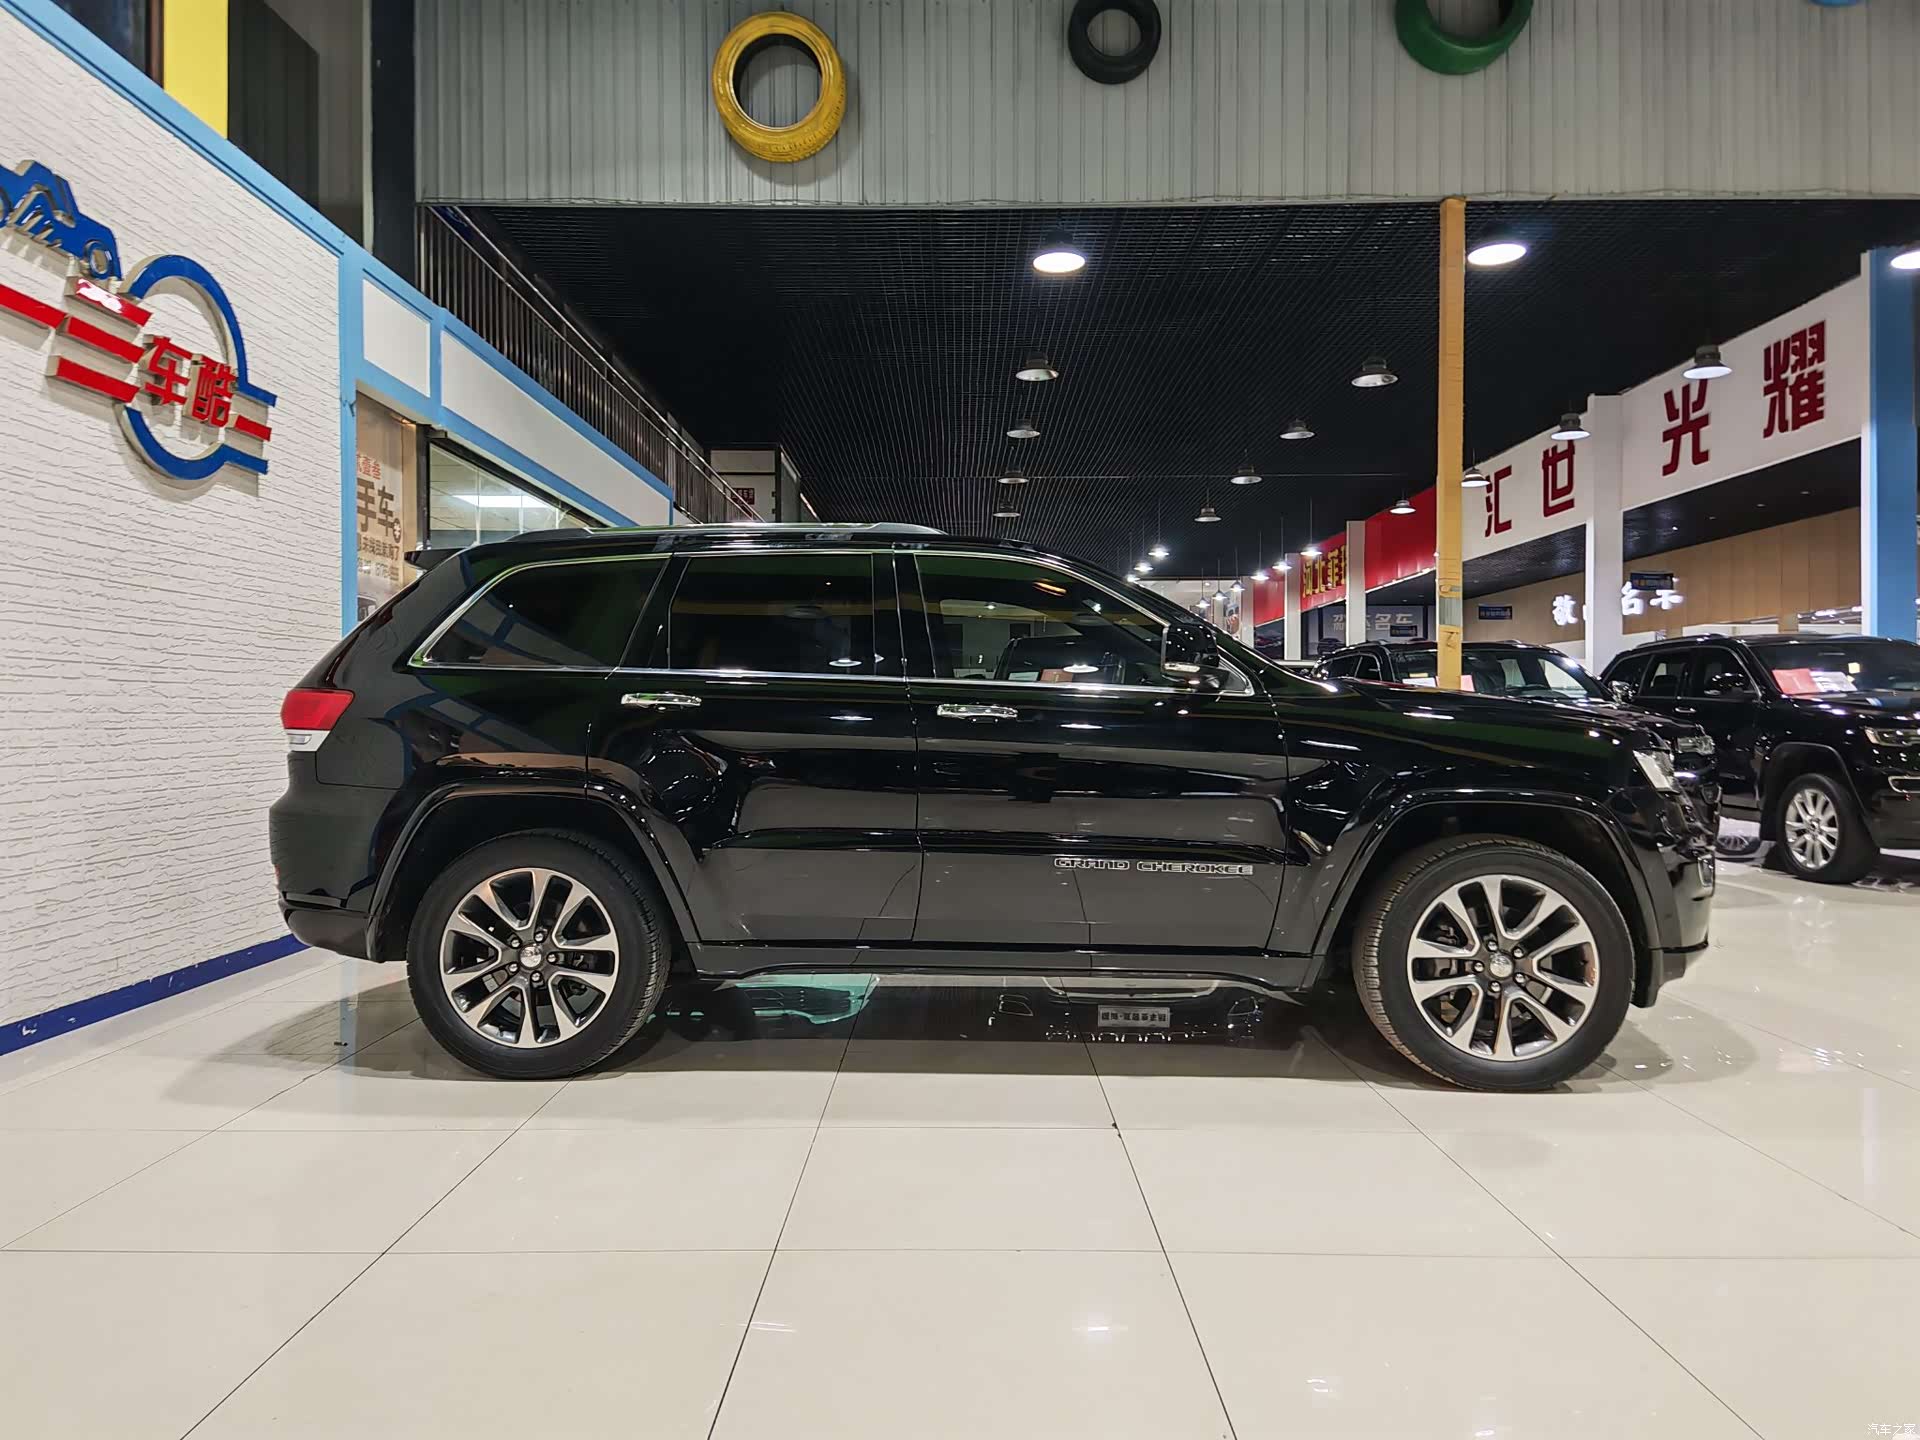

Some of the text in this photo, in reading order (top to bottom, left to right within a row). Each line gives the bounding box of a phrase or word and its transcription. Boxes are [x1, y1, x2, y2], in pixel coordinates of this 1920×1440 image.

[144, 336, 237, 427] 车酷
[1054, 857, 1254, 876] GRAND CHEROKEE
